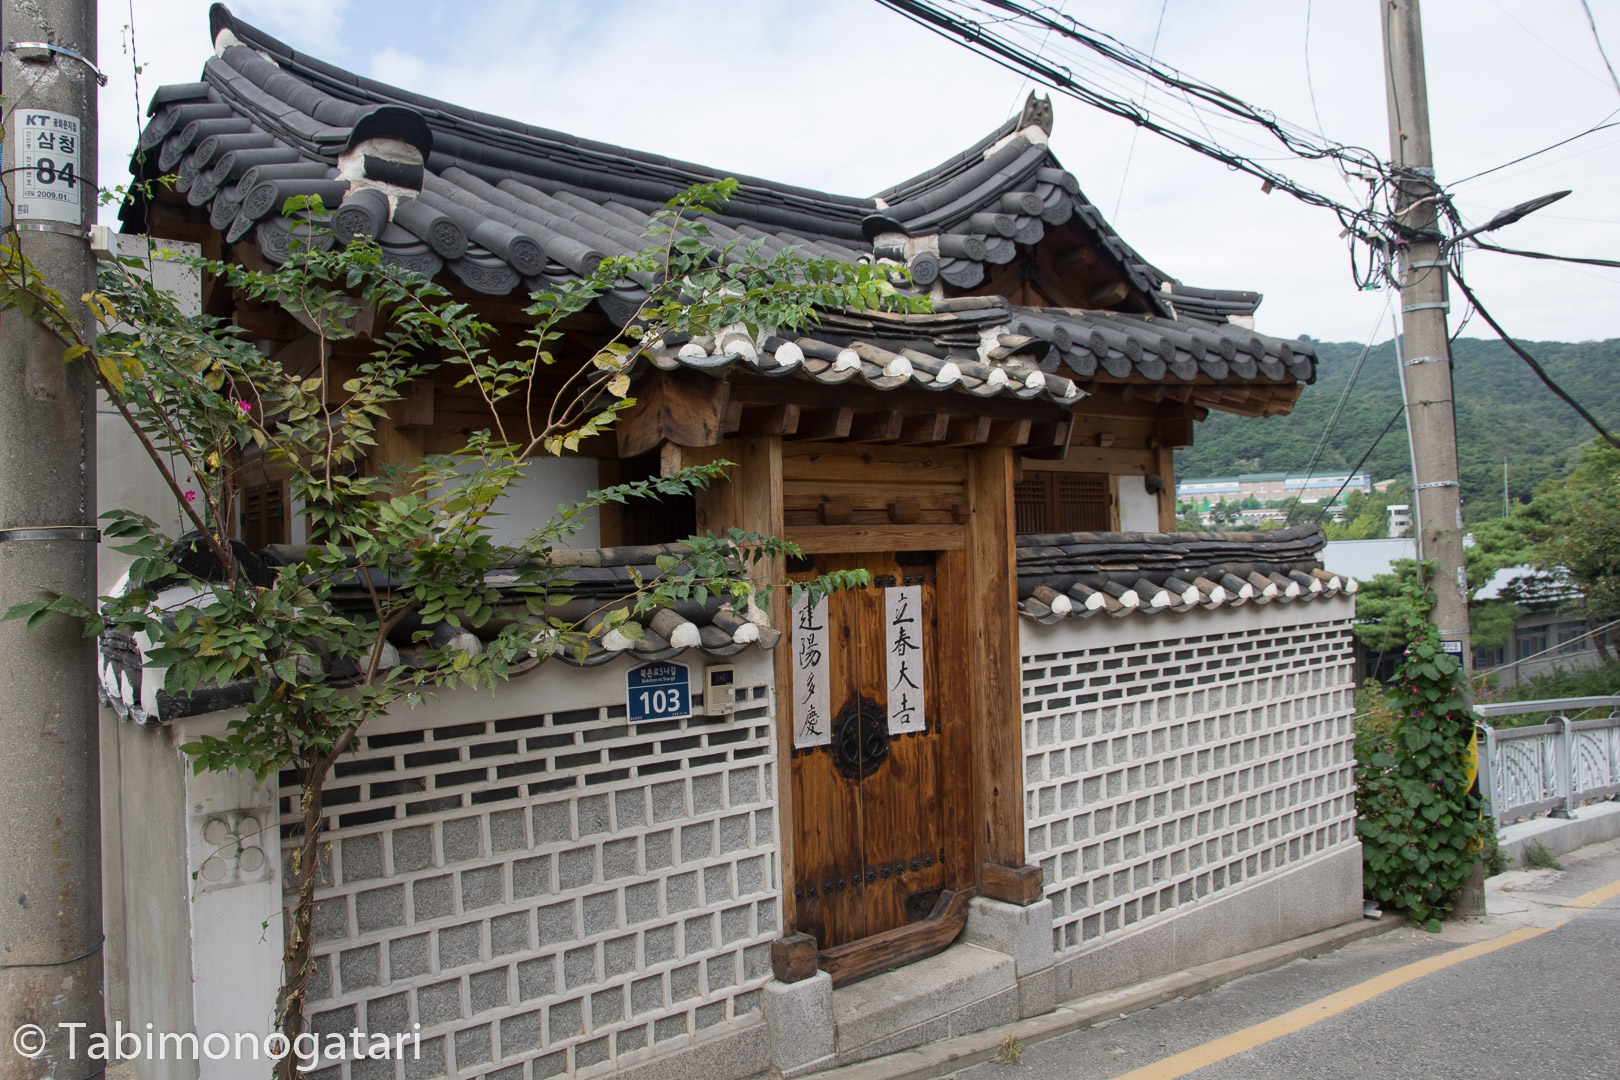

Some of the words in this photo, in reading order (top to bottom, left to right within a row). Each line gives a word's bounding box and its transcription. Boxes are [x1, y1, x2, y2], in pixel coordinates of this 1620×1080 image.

[26, 114, 50, 127] KT
[37, 132, 75, 154] 삼청
[36, 157, 76, 188] 84
[892, 592, 920, 724] 立春大吉
[639, 689, 680, 715] 103
